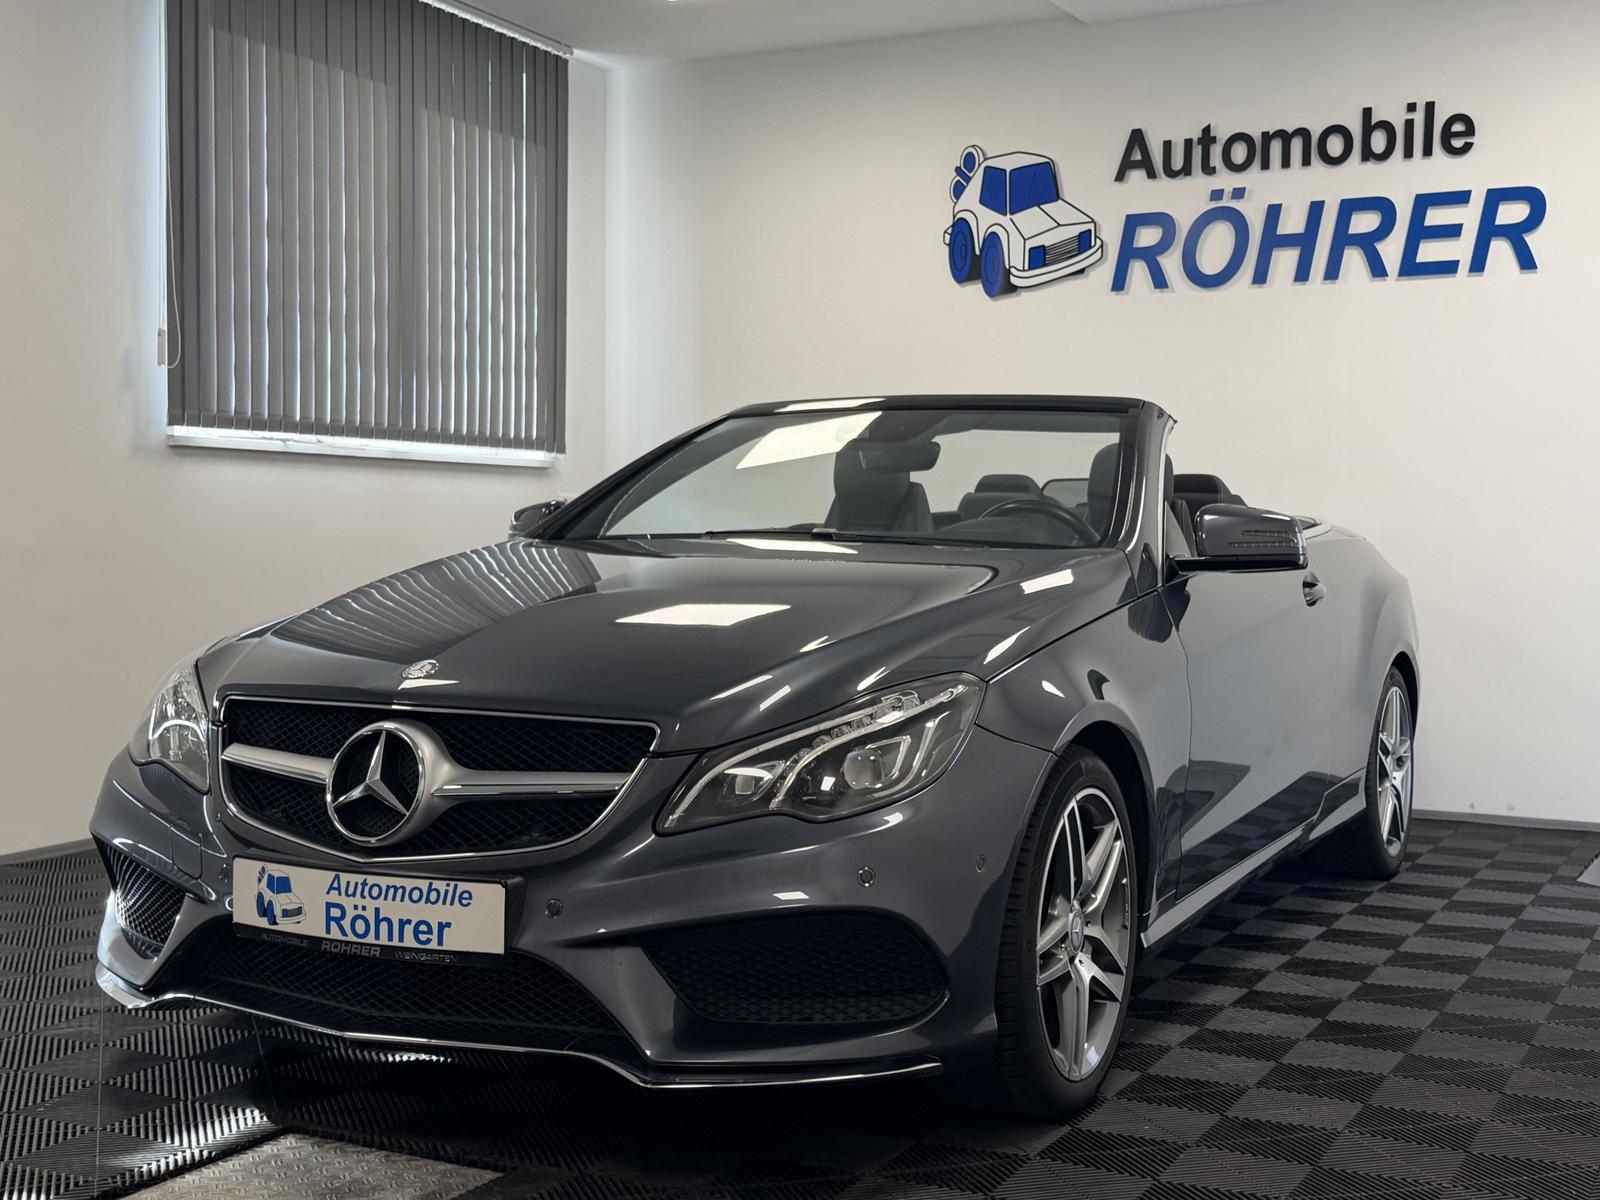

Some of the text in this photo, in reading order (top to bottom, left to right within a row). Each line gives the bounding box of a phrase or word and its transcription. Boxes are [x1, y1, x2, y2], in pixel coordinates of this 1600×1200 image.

[1114, 101, 1476, 182] Automobile
[1110, 186, 1548, 293] RÖHRER
[325, 872, 474, 908] Automobile
[324, 901, 452, 947] Röhrer
[393, 950, 459, 963] WEINGARTEN
